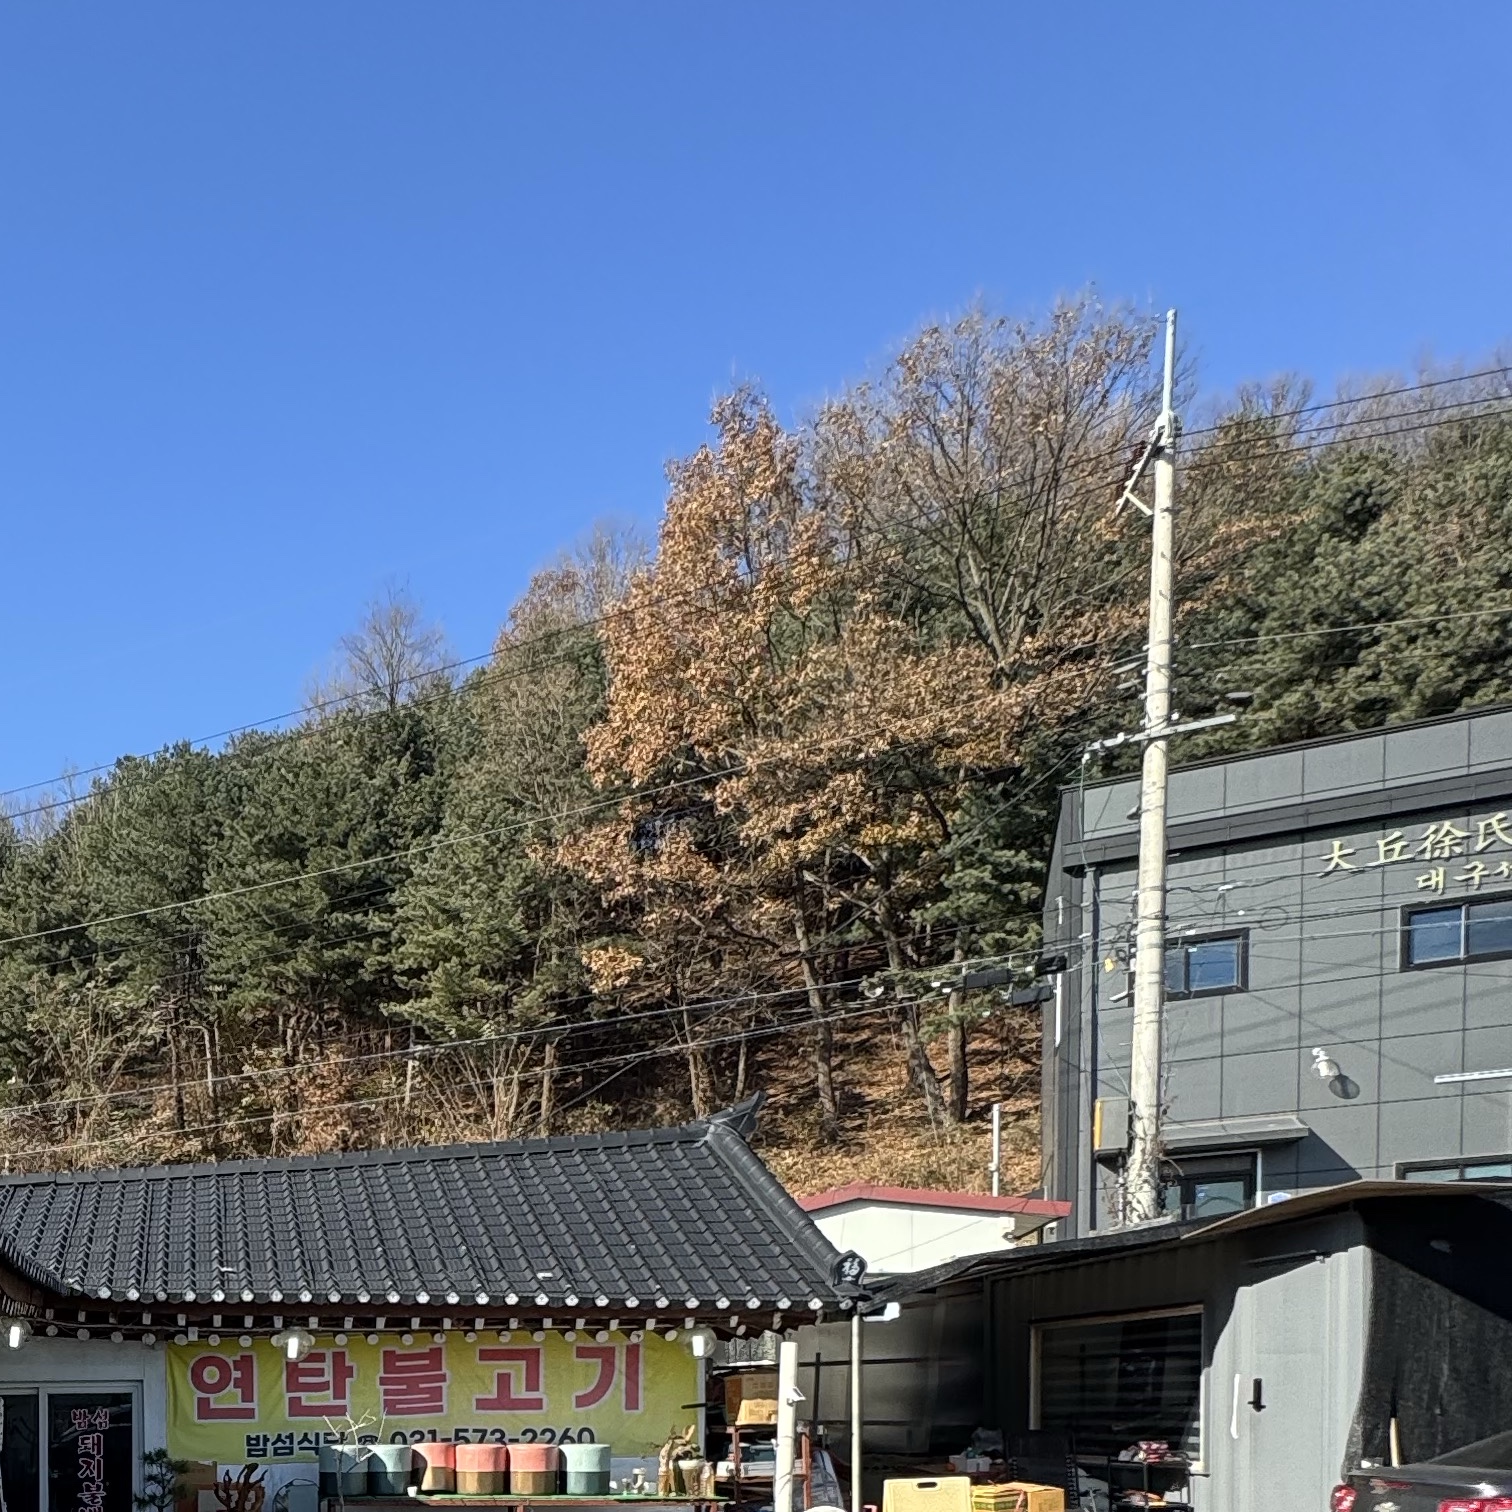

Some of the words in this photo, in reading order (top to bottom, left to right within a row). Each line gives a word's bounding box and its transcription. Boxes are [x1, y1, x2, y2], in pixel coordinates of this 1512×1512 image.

[1316, 812, 1512, 878] 大丘徐氏
[189, 1343, 643, 1421] 연탄불고기
[71, 1409, 110, 1430] 밤섬
